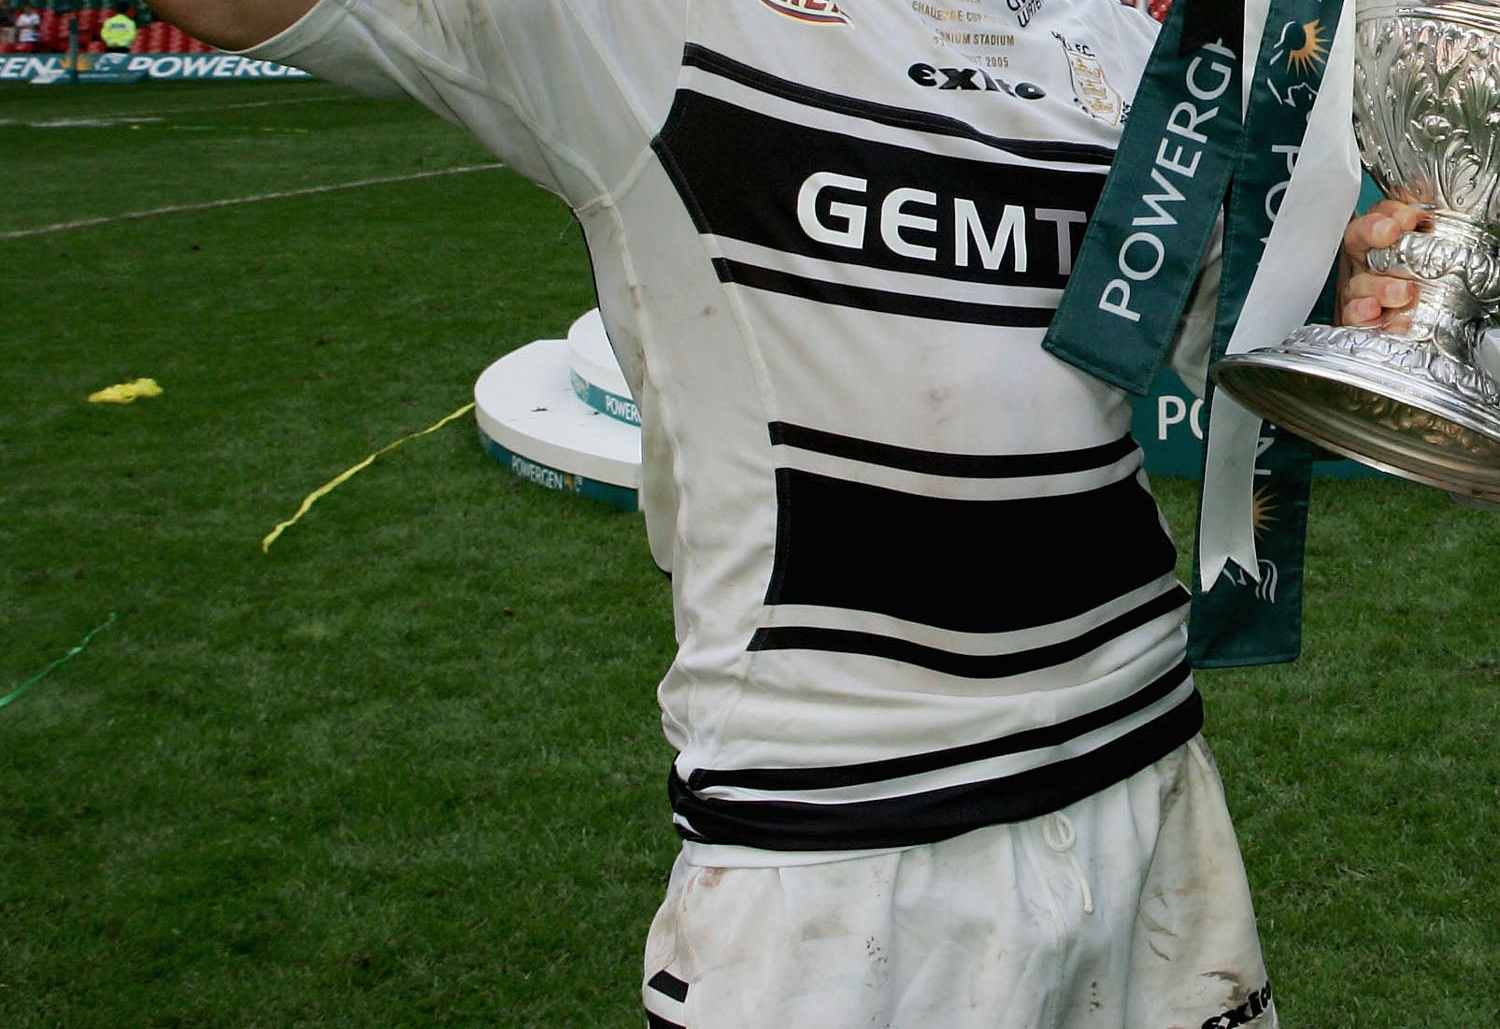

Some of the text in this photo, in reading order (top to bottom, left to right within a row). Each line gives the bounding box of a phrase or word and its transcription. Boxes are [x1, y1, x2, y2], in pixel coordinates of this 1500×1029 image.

[973, 33, 1015, 46] STADIUM
[986, 56, 1009, 68] 2005
[511, 455, 564, 489] POWERGEN
